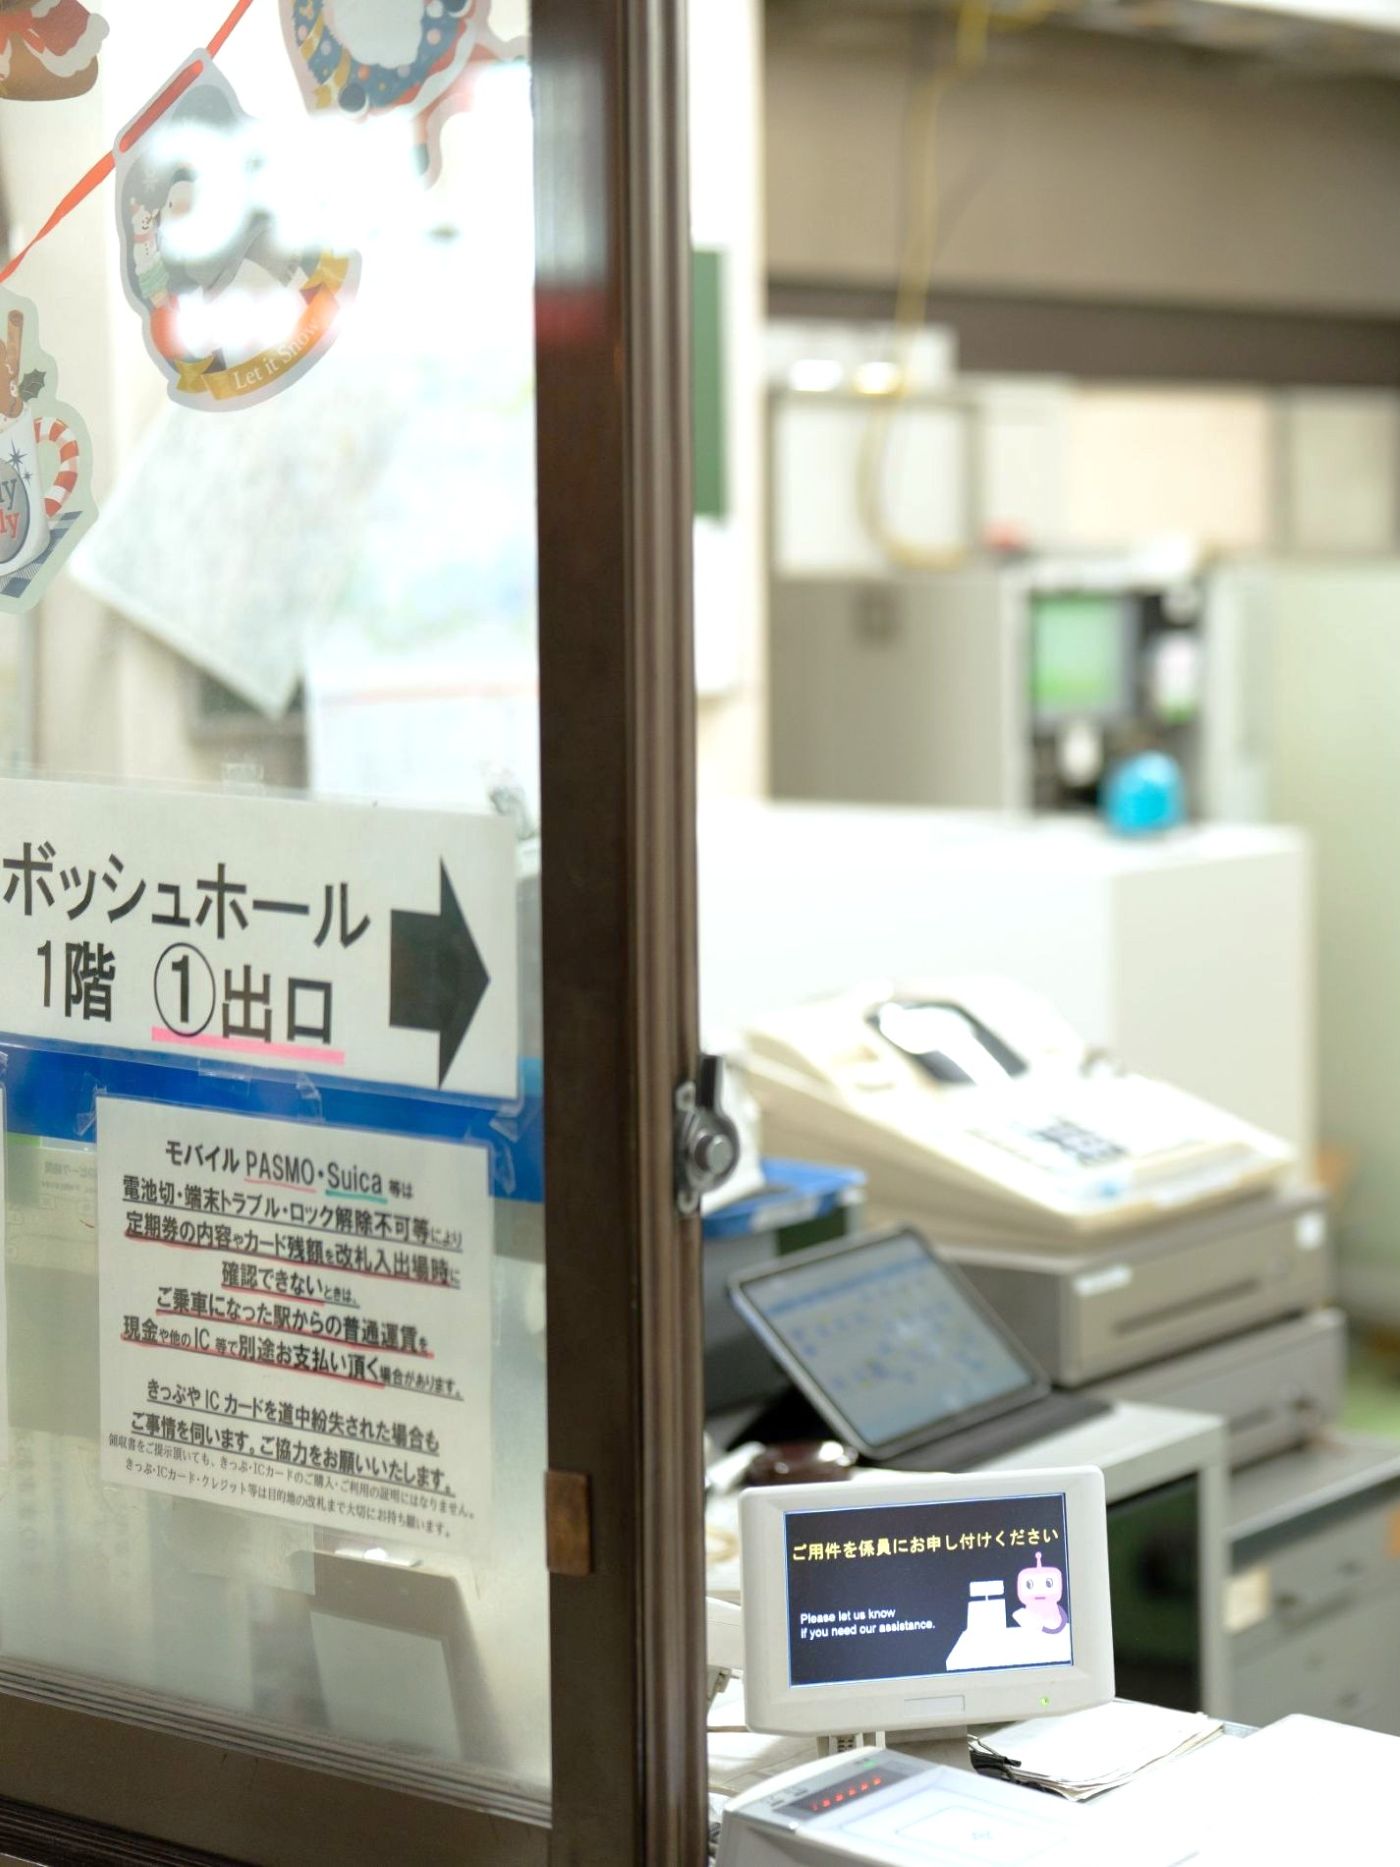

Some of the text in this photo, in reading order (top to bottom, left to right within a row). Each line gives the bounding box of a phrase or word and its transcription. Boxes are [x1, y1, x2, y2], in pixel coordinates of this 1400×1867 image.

[233, 321, 320, 390] Let it Snow
[2, 841, 371, 948] ボッシュホール
[36, 940, 116, 1022] 1階
[165, 1140, 240, 1174] モバイル
[123, 1175, 463, 1249] 電池切・端末トラブル・ロック解除不可等により
[126, 1210, 461, 1286] 定期券の内容やカード残額を改札入出場時に
[157, 1286, 429, 1355] ご乗車になった駅からの普通運賃を
[792, 1528, 1059, 1562] ご用件を係員にお申し付けください
[800, 1608, 896, 1625] Please let us know
[809, 1628, 829, 1641] you
[831, 1624, 857, 1637] need
[859, 1623, 876, 1635] our
[878, 1619, 936, 1633] assistance.
